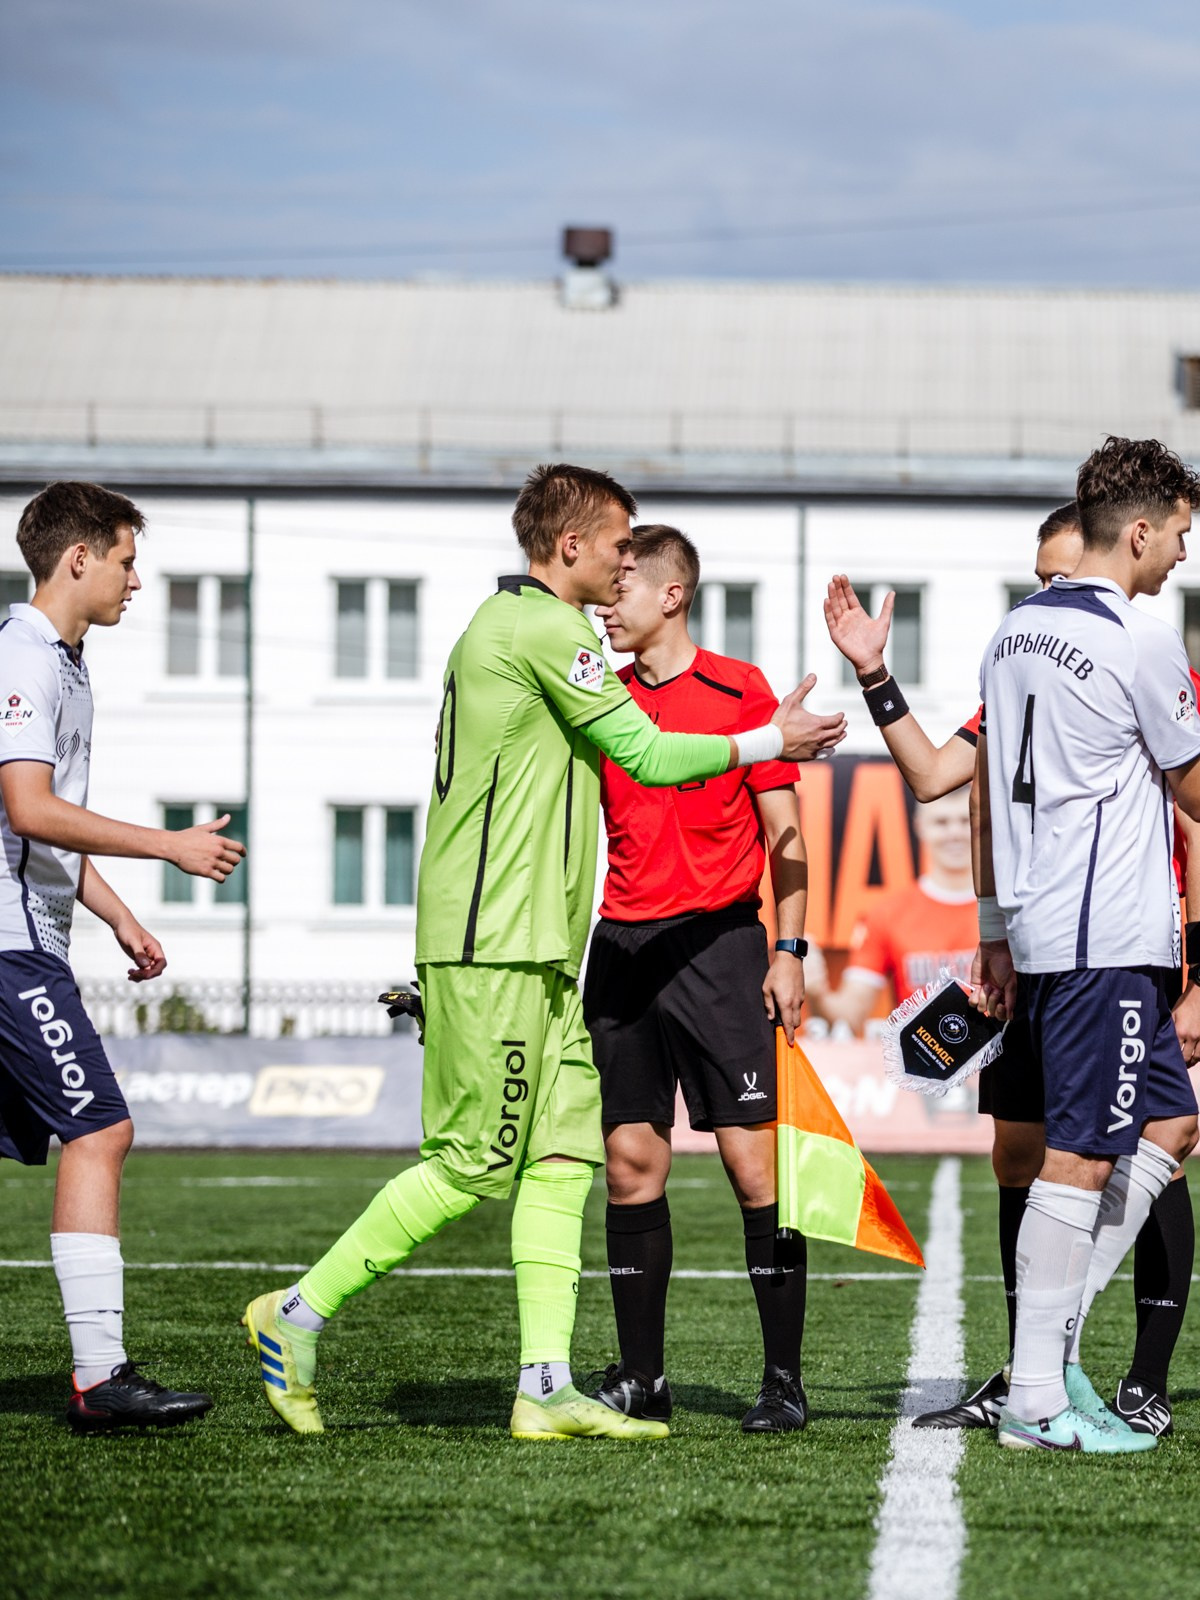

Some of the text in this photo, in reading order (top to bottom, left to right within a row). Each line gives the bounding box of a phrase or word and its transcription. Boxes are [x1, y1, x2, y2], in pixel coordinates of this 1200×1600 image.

[1012, 694, 1036, 835] 4
[18, 985, 95, 1117] Vorgol
[916, 1025, 955, 1067] КОСМОС
[1107, 1000, 1145, 1133] Vorgol
[127, 1071, 252, 1109] астер
[487, 1040, 529, 1172] Vorgol
[738, 1091, 768, 1101] JÖGEL
[1139, 1298, 1179, 1307] JÖGEL
